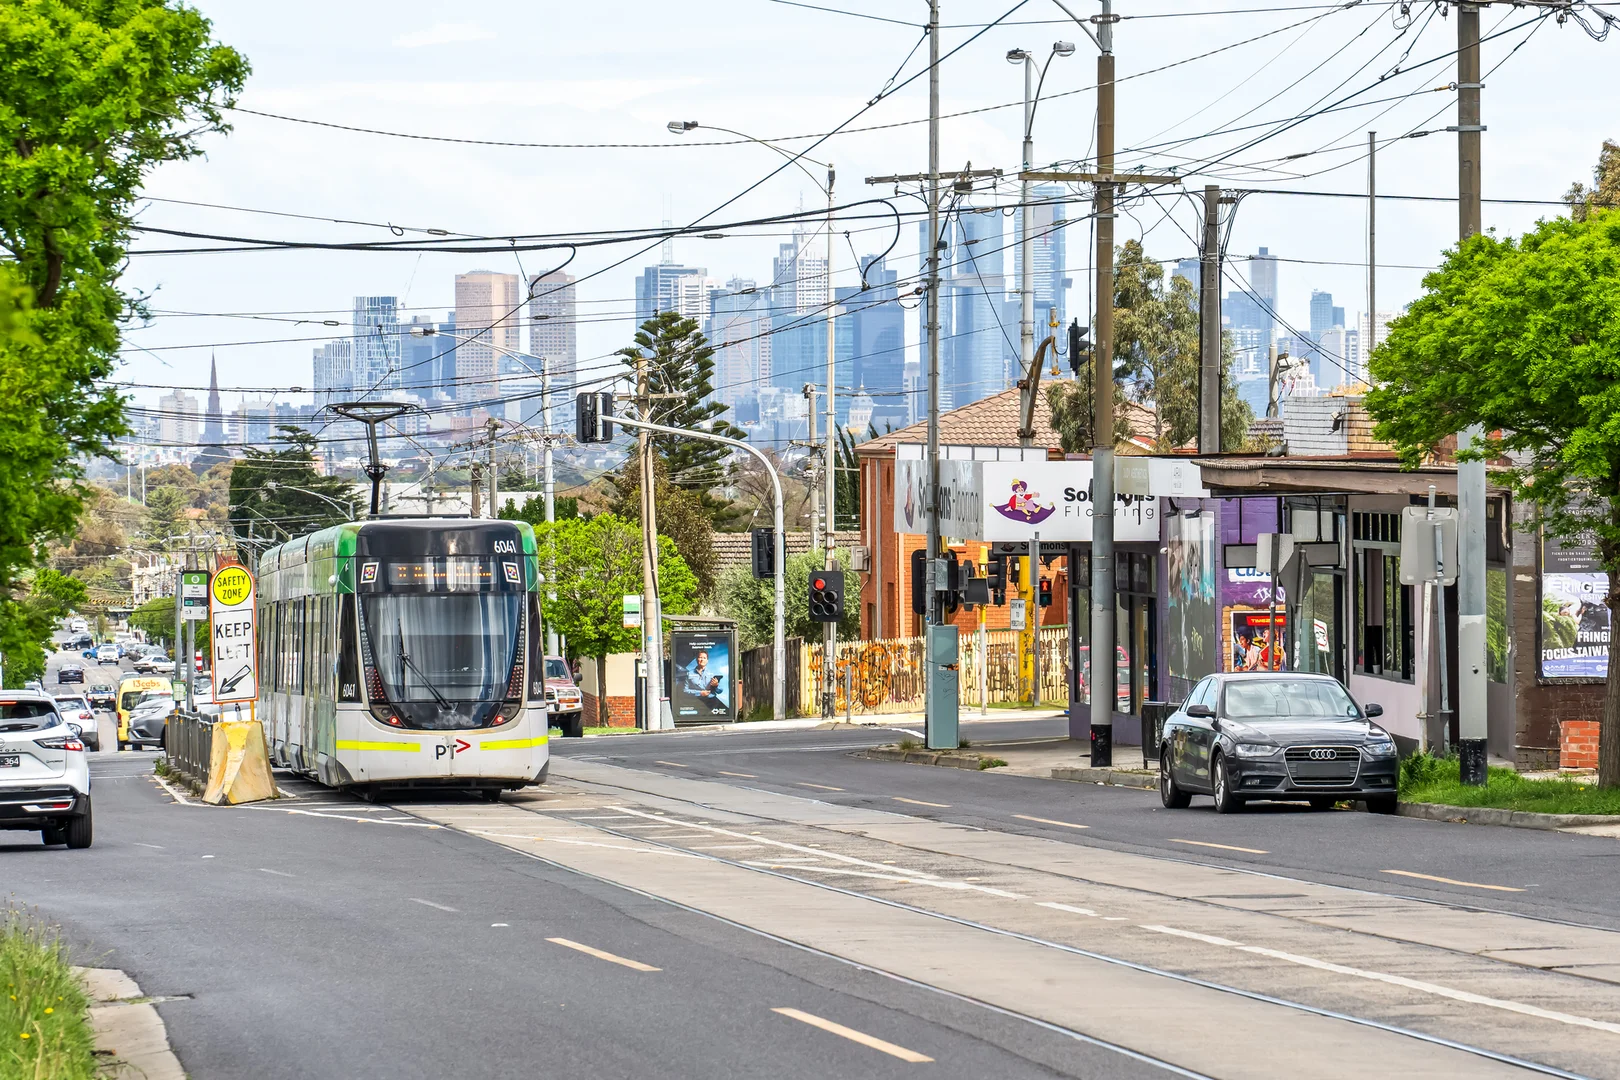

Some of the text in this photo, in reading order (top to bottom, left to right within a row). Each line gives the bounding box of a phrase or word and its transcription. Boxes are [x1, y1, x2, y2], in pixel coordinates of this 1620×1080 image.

[918, 476, 951, 521] Soons
[1064, 505, 1154, 520] Floring
[494, 540, 517, 554] 6041
[217, 575, 246, 588] SAFETY
[222, 588, 242, 600] ZONE
[1581, 593, 1607, 601] FESTIVA
[215, 621, 252, 639] KEEP
[1577, 631, 1610, 643] FRING
[1575, 645, 1610, 658] TAIWA
[132, 680, 160, 688] 13cabs
[343, 683, 355, 698] 6041
